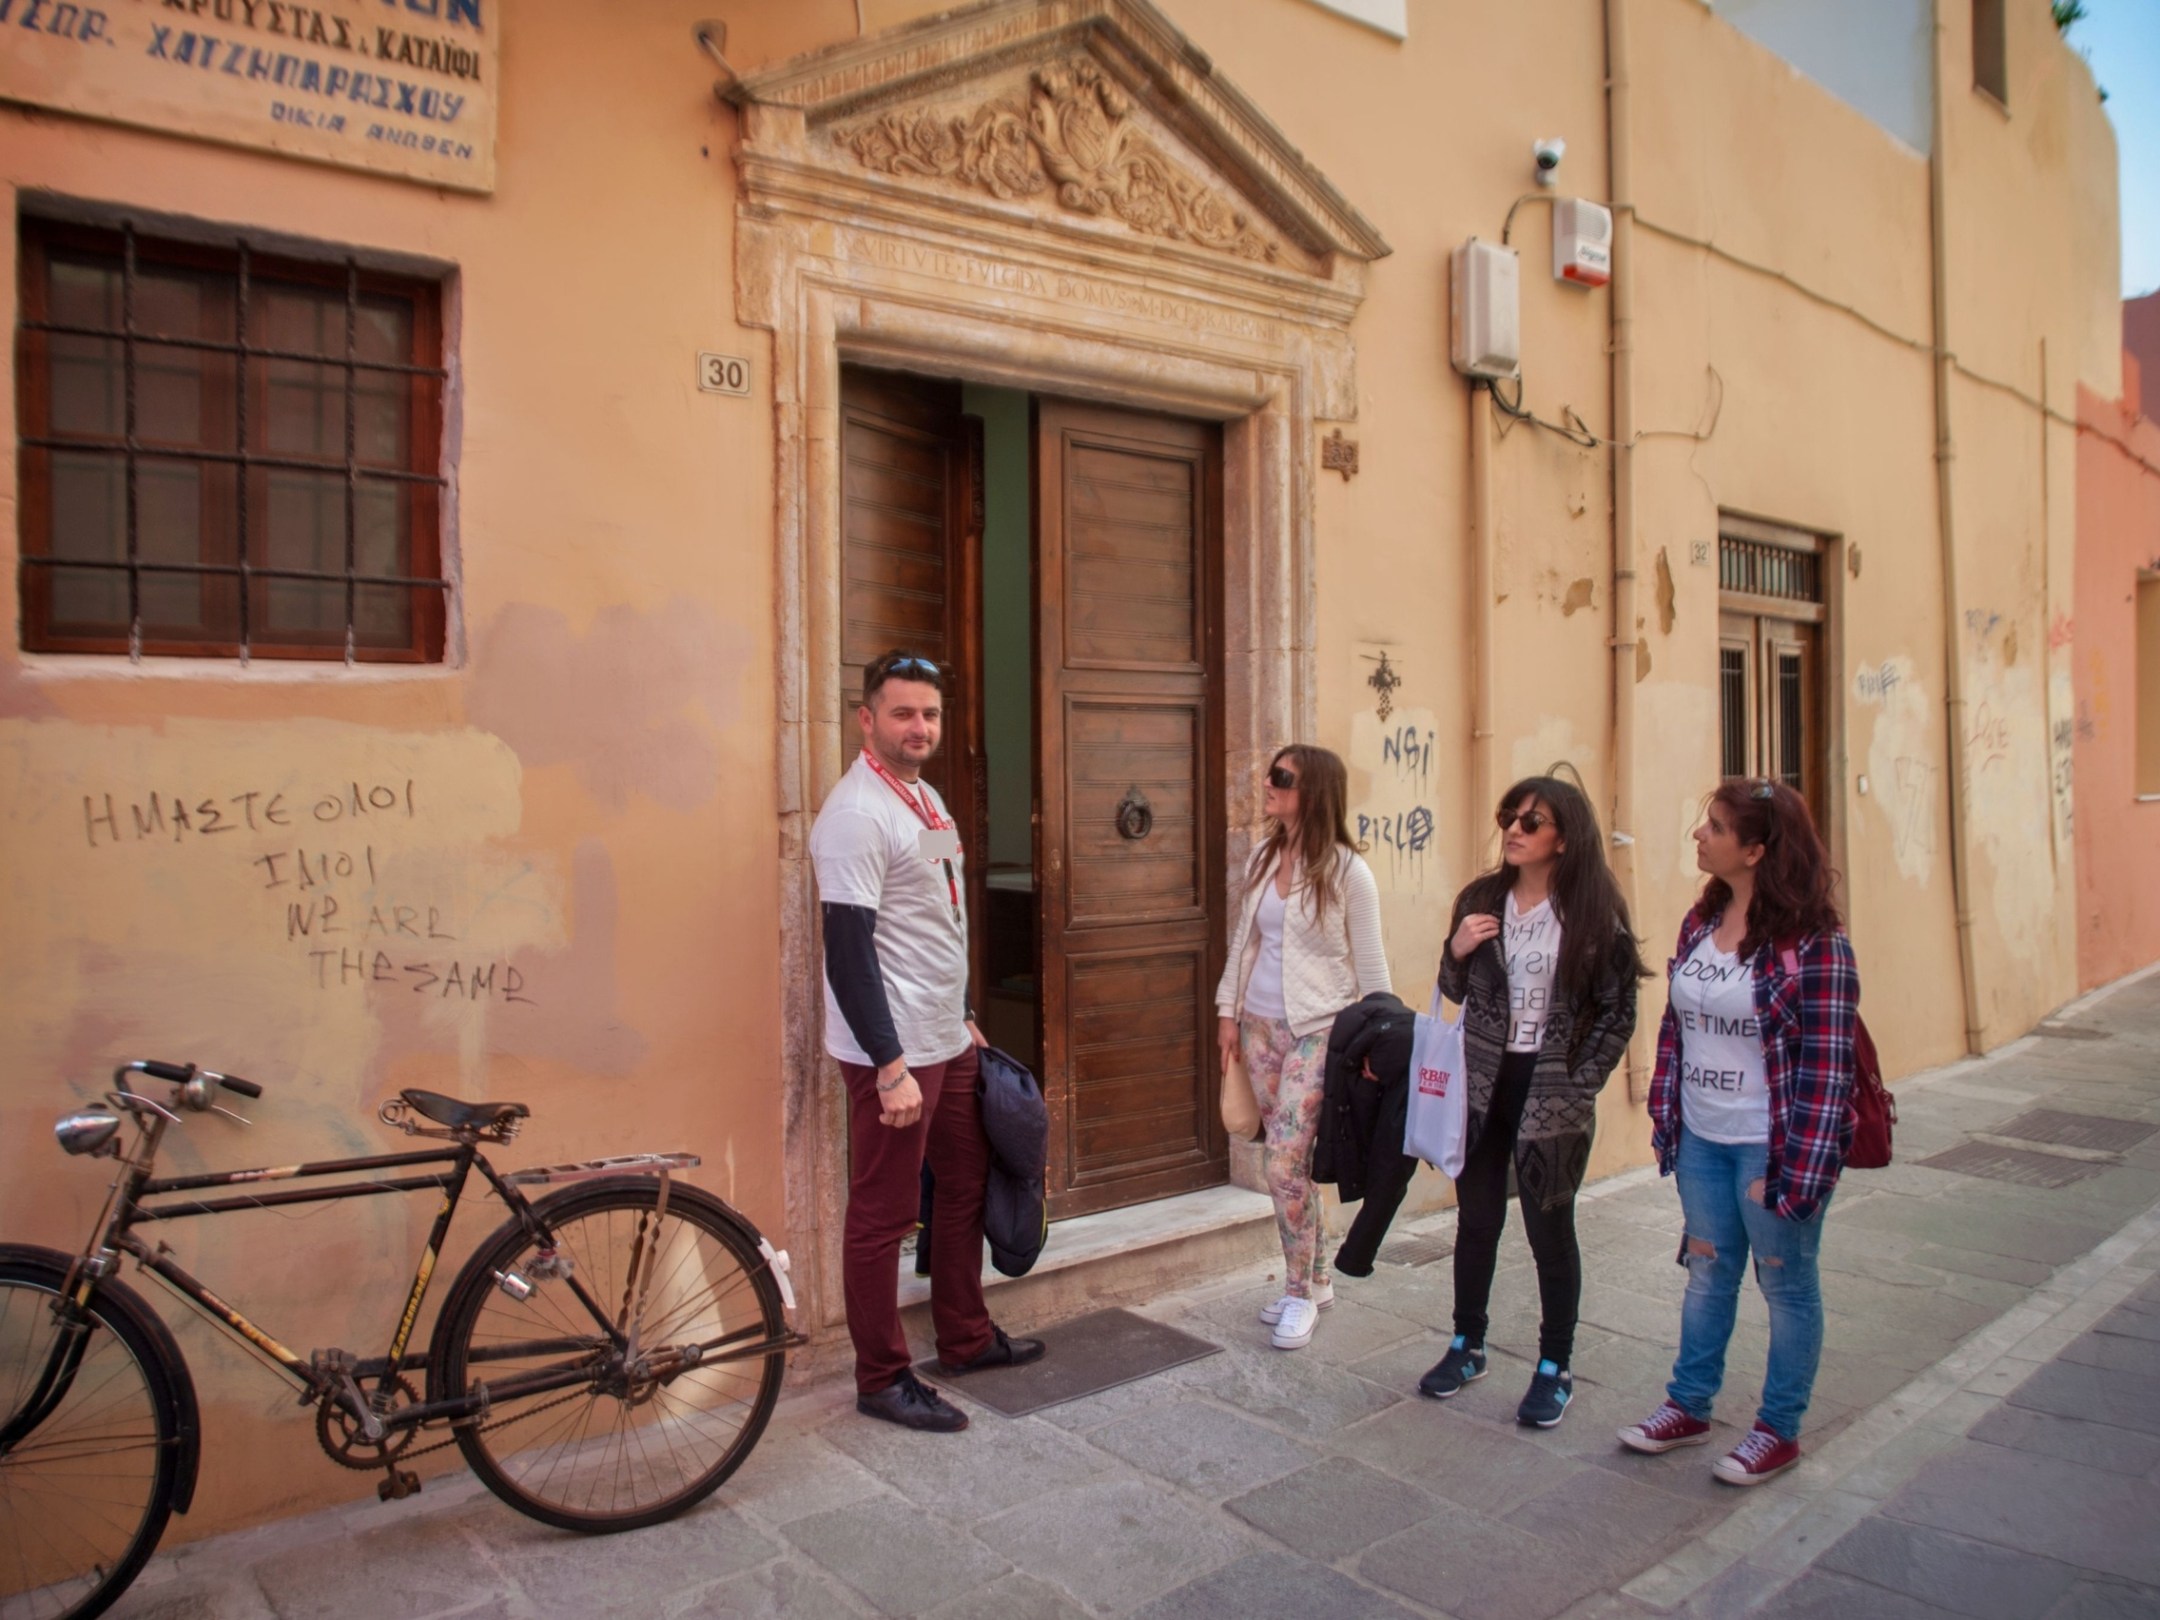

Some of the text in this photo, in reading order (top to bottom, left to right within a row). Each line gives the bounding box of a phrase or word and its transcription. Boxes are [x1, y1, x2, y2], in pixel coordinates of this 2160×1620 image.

[708, 358, 743, 388] 30
[1693, 542, 1708, 561] 32
[1700, 1012, 1758, 1037] TIME
